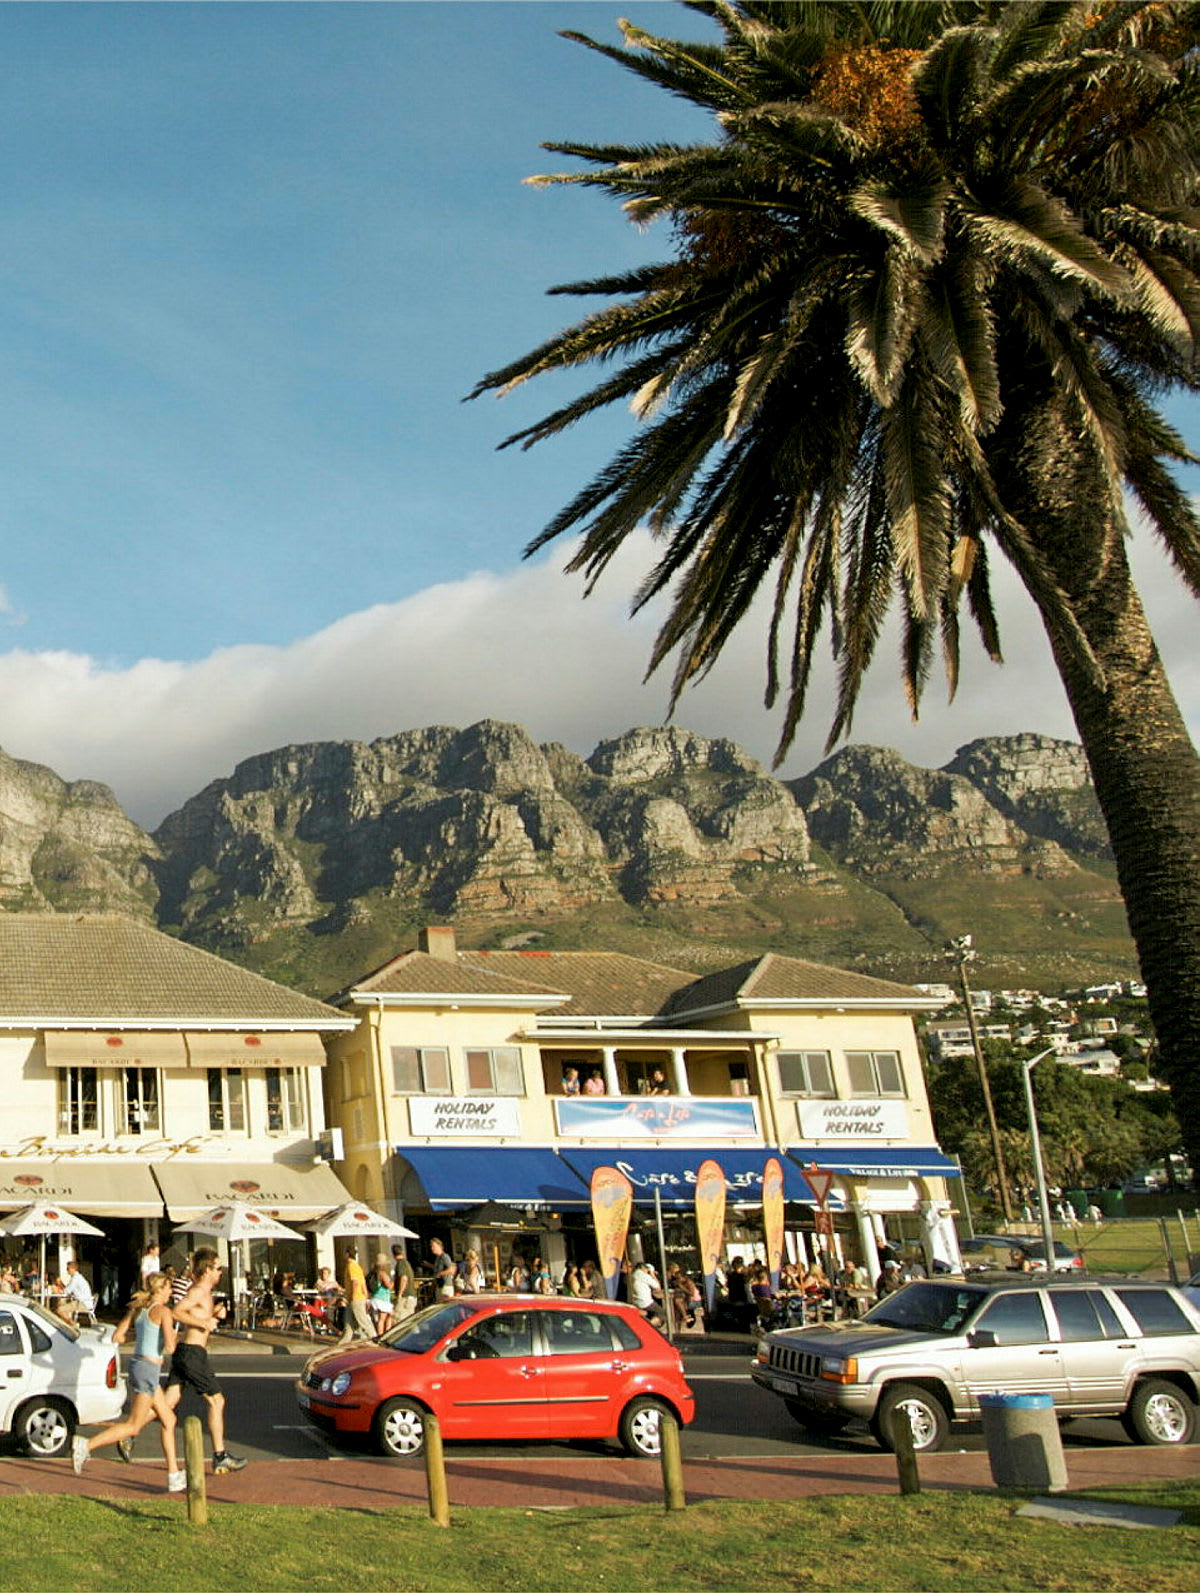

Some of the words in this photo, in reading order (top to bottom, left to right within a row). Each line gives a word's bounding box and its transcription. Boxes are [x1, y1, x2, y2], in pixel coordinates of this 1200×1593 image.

[434, 1102, 495, 1115] HOLIDAY
[823, 1105, 881, 1116] HOLIDAY
[435, 1117, 498, 1130] RENTALS
[825, 1121, 885, 1134] RENTALS
[205, 1192, 295, 1200] BACARDI
